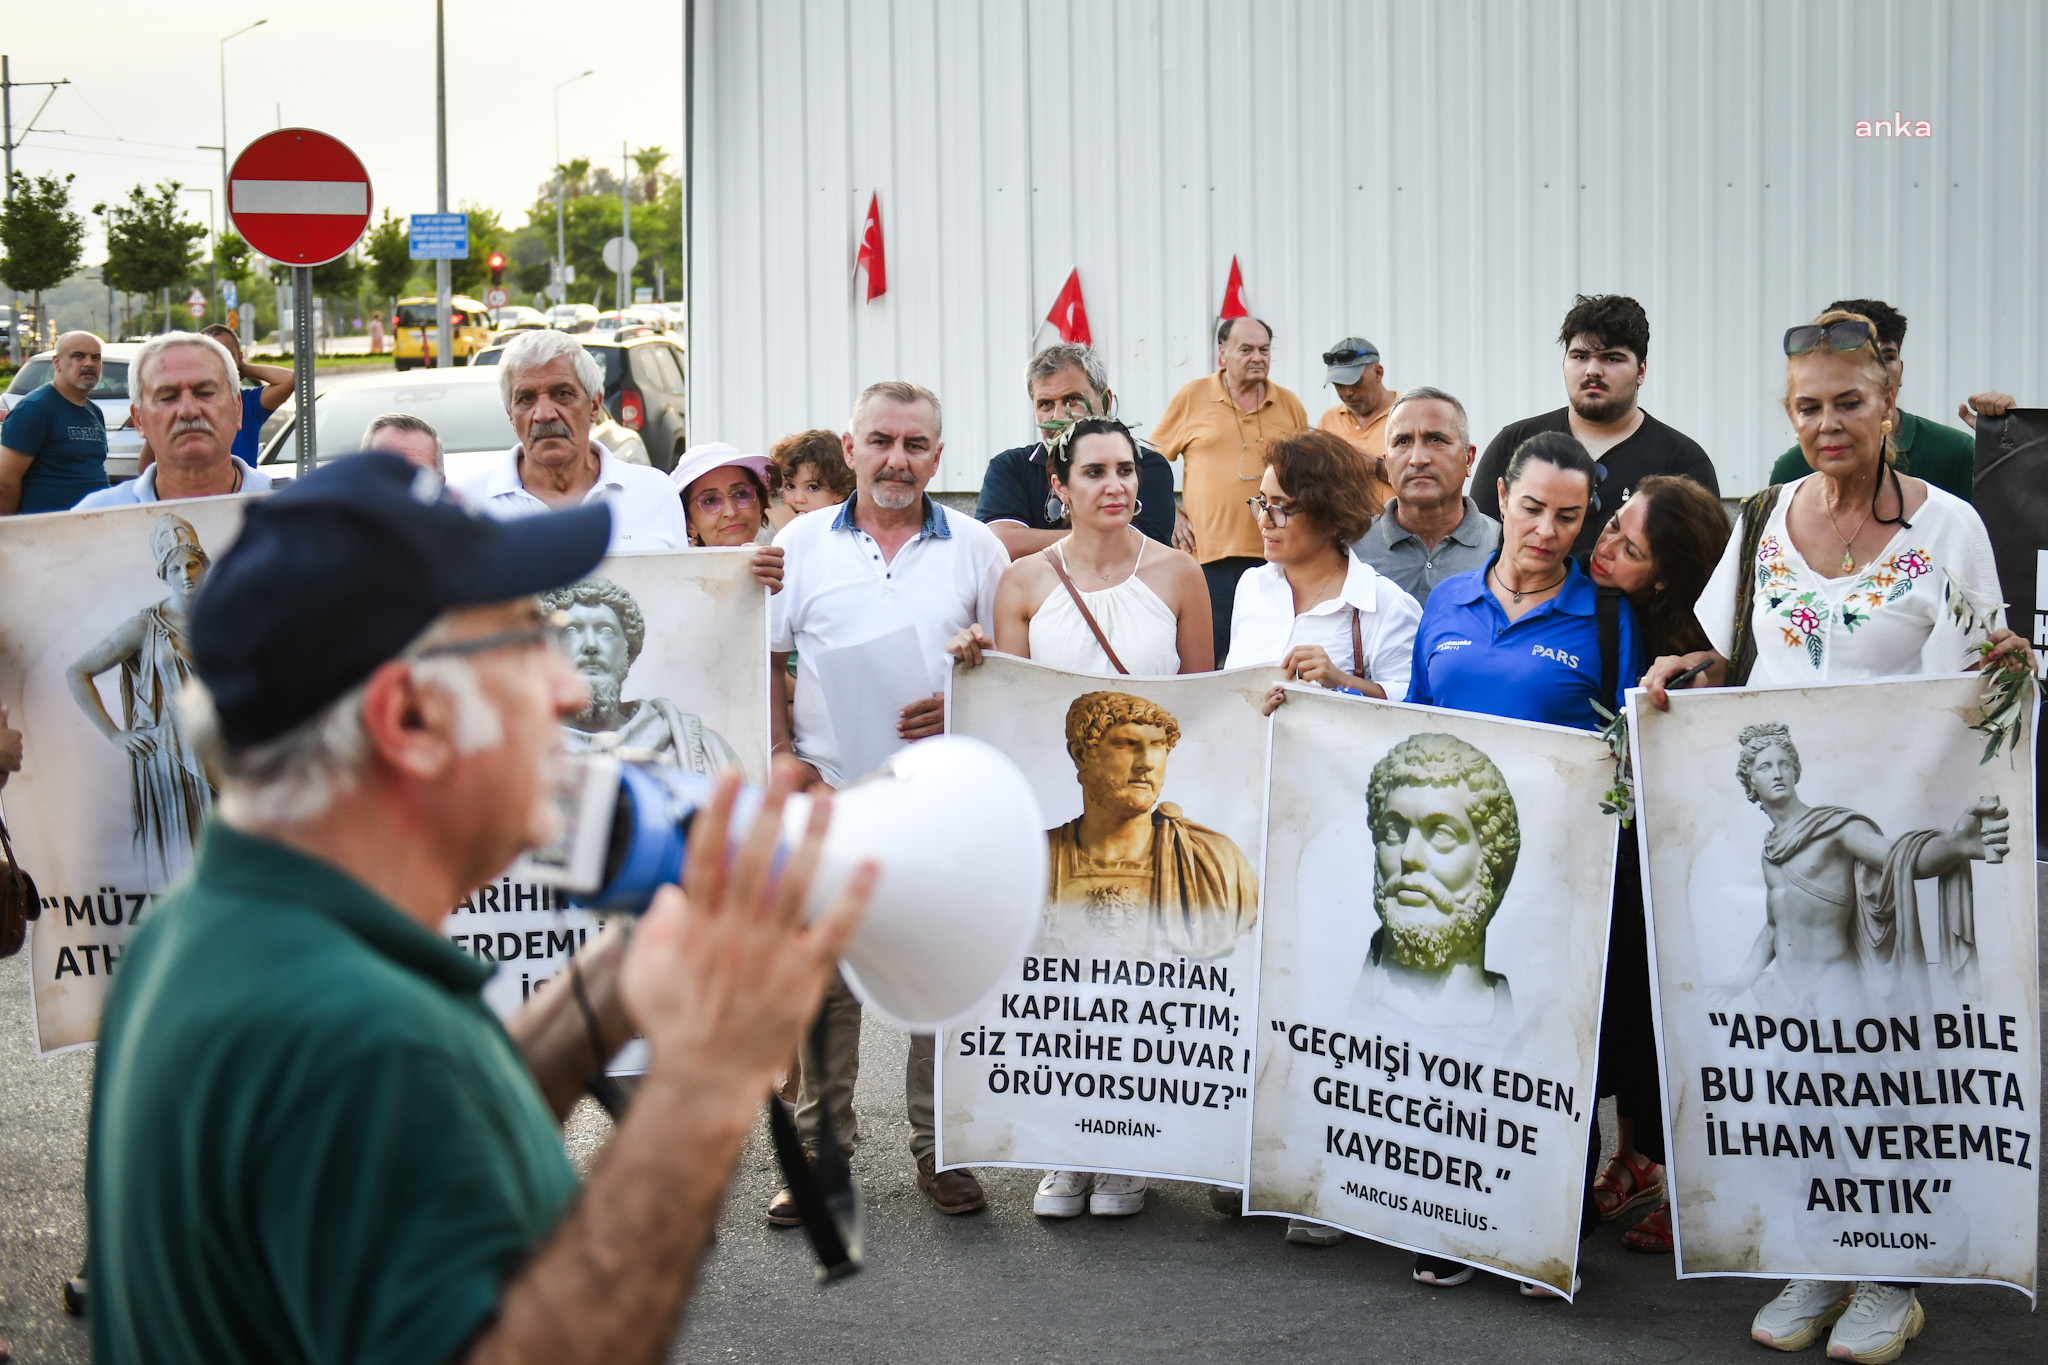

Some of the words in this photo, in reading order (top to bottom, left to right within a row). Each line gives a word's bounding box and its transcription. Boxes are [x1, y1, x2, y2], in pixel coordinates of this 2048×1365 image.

[1531, 644, 1580, 669] PARS
[41, 887, 159, 927] “MÜZ
[54, 944, 127, 980] ATH
[1022, 956, 1080, 983] BEN
[1091, 957, 1236, 997] HADRİAN,
[1001, 993, 1129, 1024] KAPILAR
[1138, 1000, 1240, 1037] AÇTIM;
[1708, 1012, 1921, 1054] “APOLLON
[1933, 1004, 2019, 1053] BİLE
[959, 1025, 1006, 1056] SİZ
[1015, 1028, 1123, 1062] TARİHE
[1132, 1037, 1235, 1072] DUVAR
[1271, 1020, 1409, 1082] “GEÇMİŞİ
[1418, 1051, 1484, 1093] YOK
[1492, 1068, 1581, 1122] EDEN,
[988, 1063, 1247, 1110] ÖRÜYORSUNUZ?"
[1701, 1066, 1753, 1102] BU
[1766, 1068, 2025, 1112] KARANLIKTA
[1074, 1118, 1162, 1138] -HADRİAN-
[1313, 1076, 1487, 1143] GELECEĞİNİ
[1496, 1118, 1539, 1156] DE
[1705, 1112, 1836, 1160] İLHAM
[1844, 1124, 2032, 1171] VEREMEZ
[1340, 1180, 1408, 1211] -MARCUS
[1411, 1199, 1488, 1231] AURELİUS
[1806, 1177, 1952, 1214] ARTIK”
[1832, 1231, 1937, 1250] -APOLLON-
